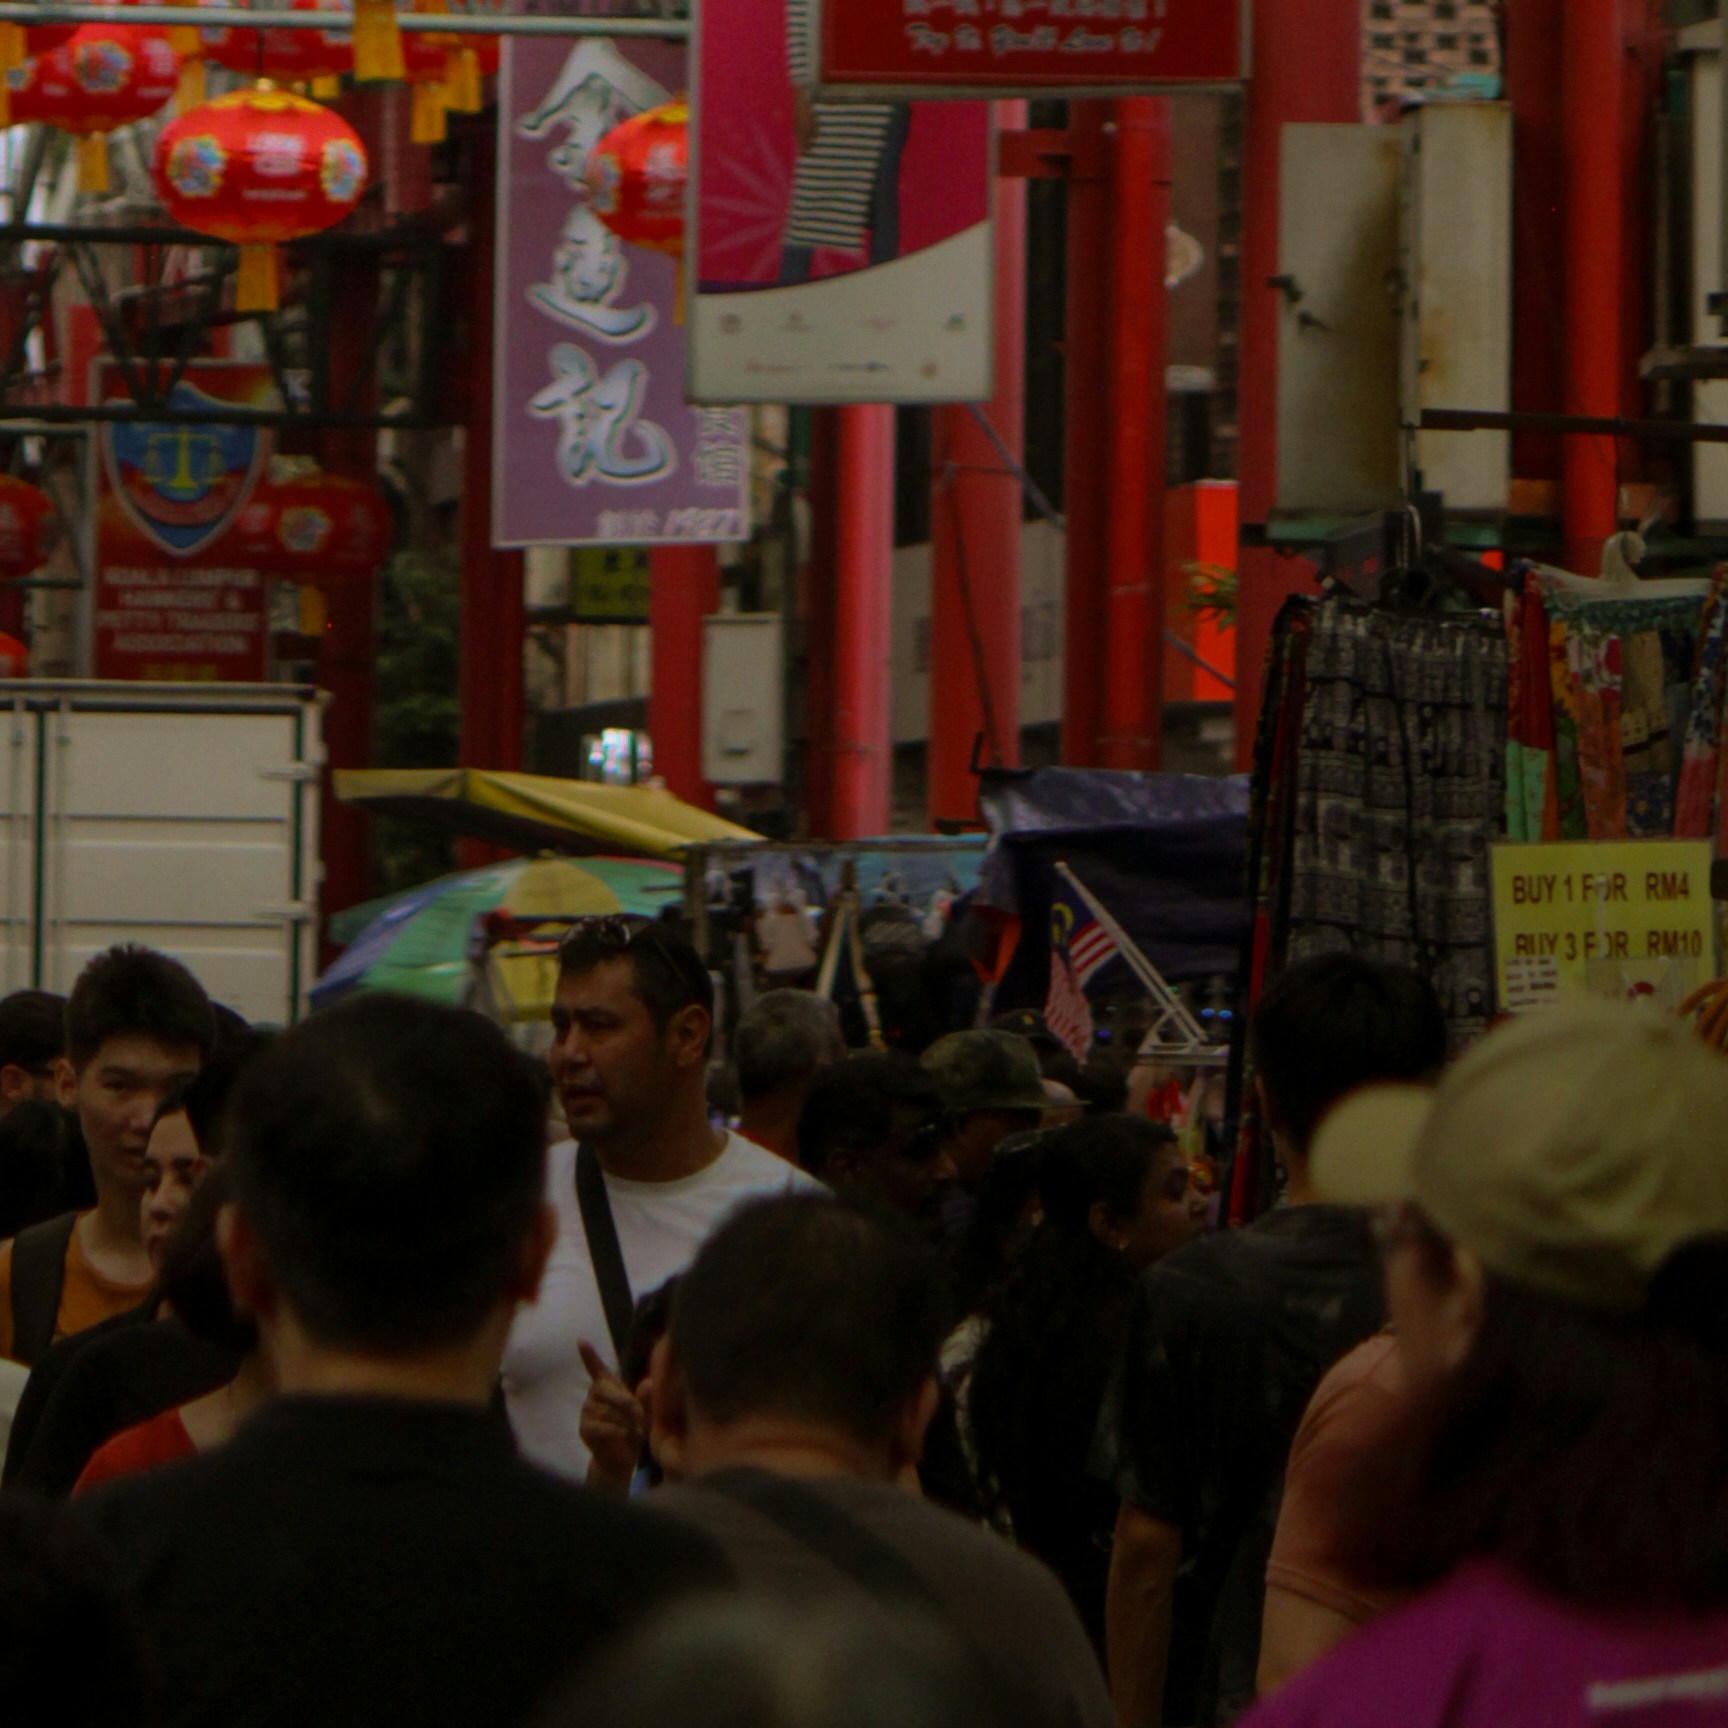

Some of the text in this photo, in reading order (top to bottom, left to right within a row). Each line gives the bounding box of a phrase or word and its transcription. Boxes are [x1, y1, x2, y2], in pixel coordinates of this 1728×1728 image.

[1513, 874, 1557, 904] BUY
[1564, 874, 1574, 901] 1
[1646, 872, 1690, 902] RM4
[1564, 931, 1577, 961] 3
